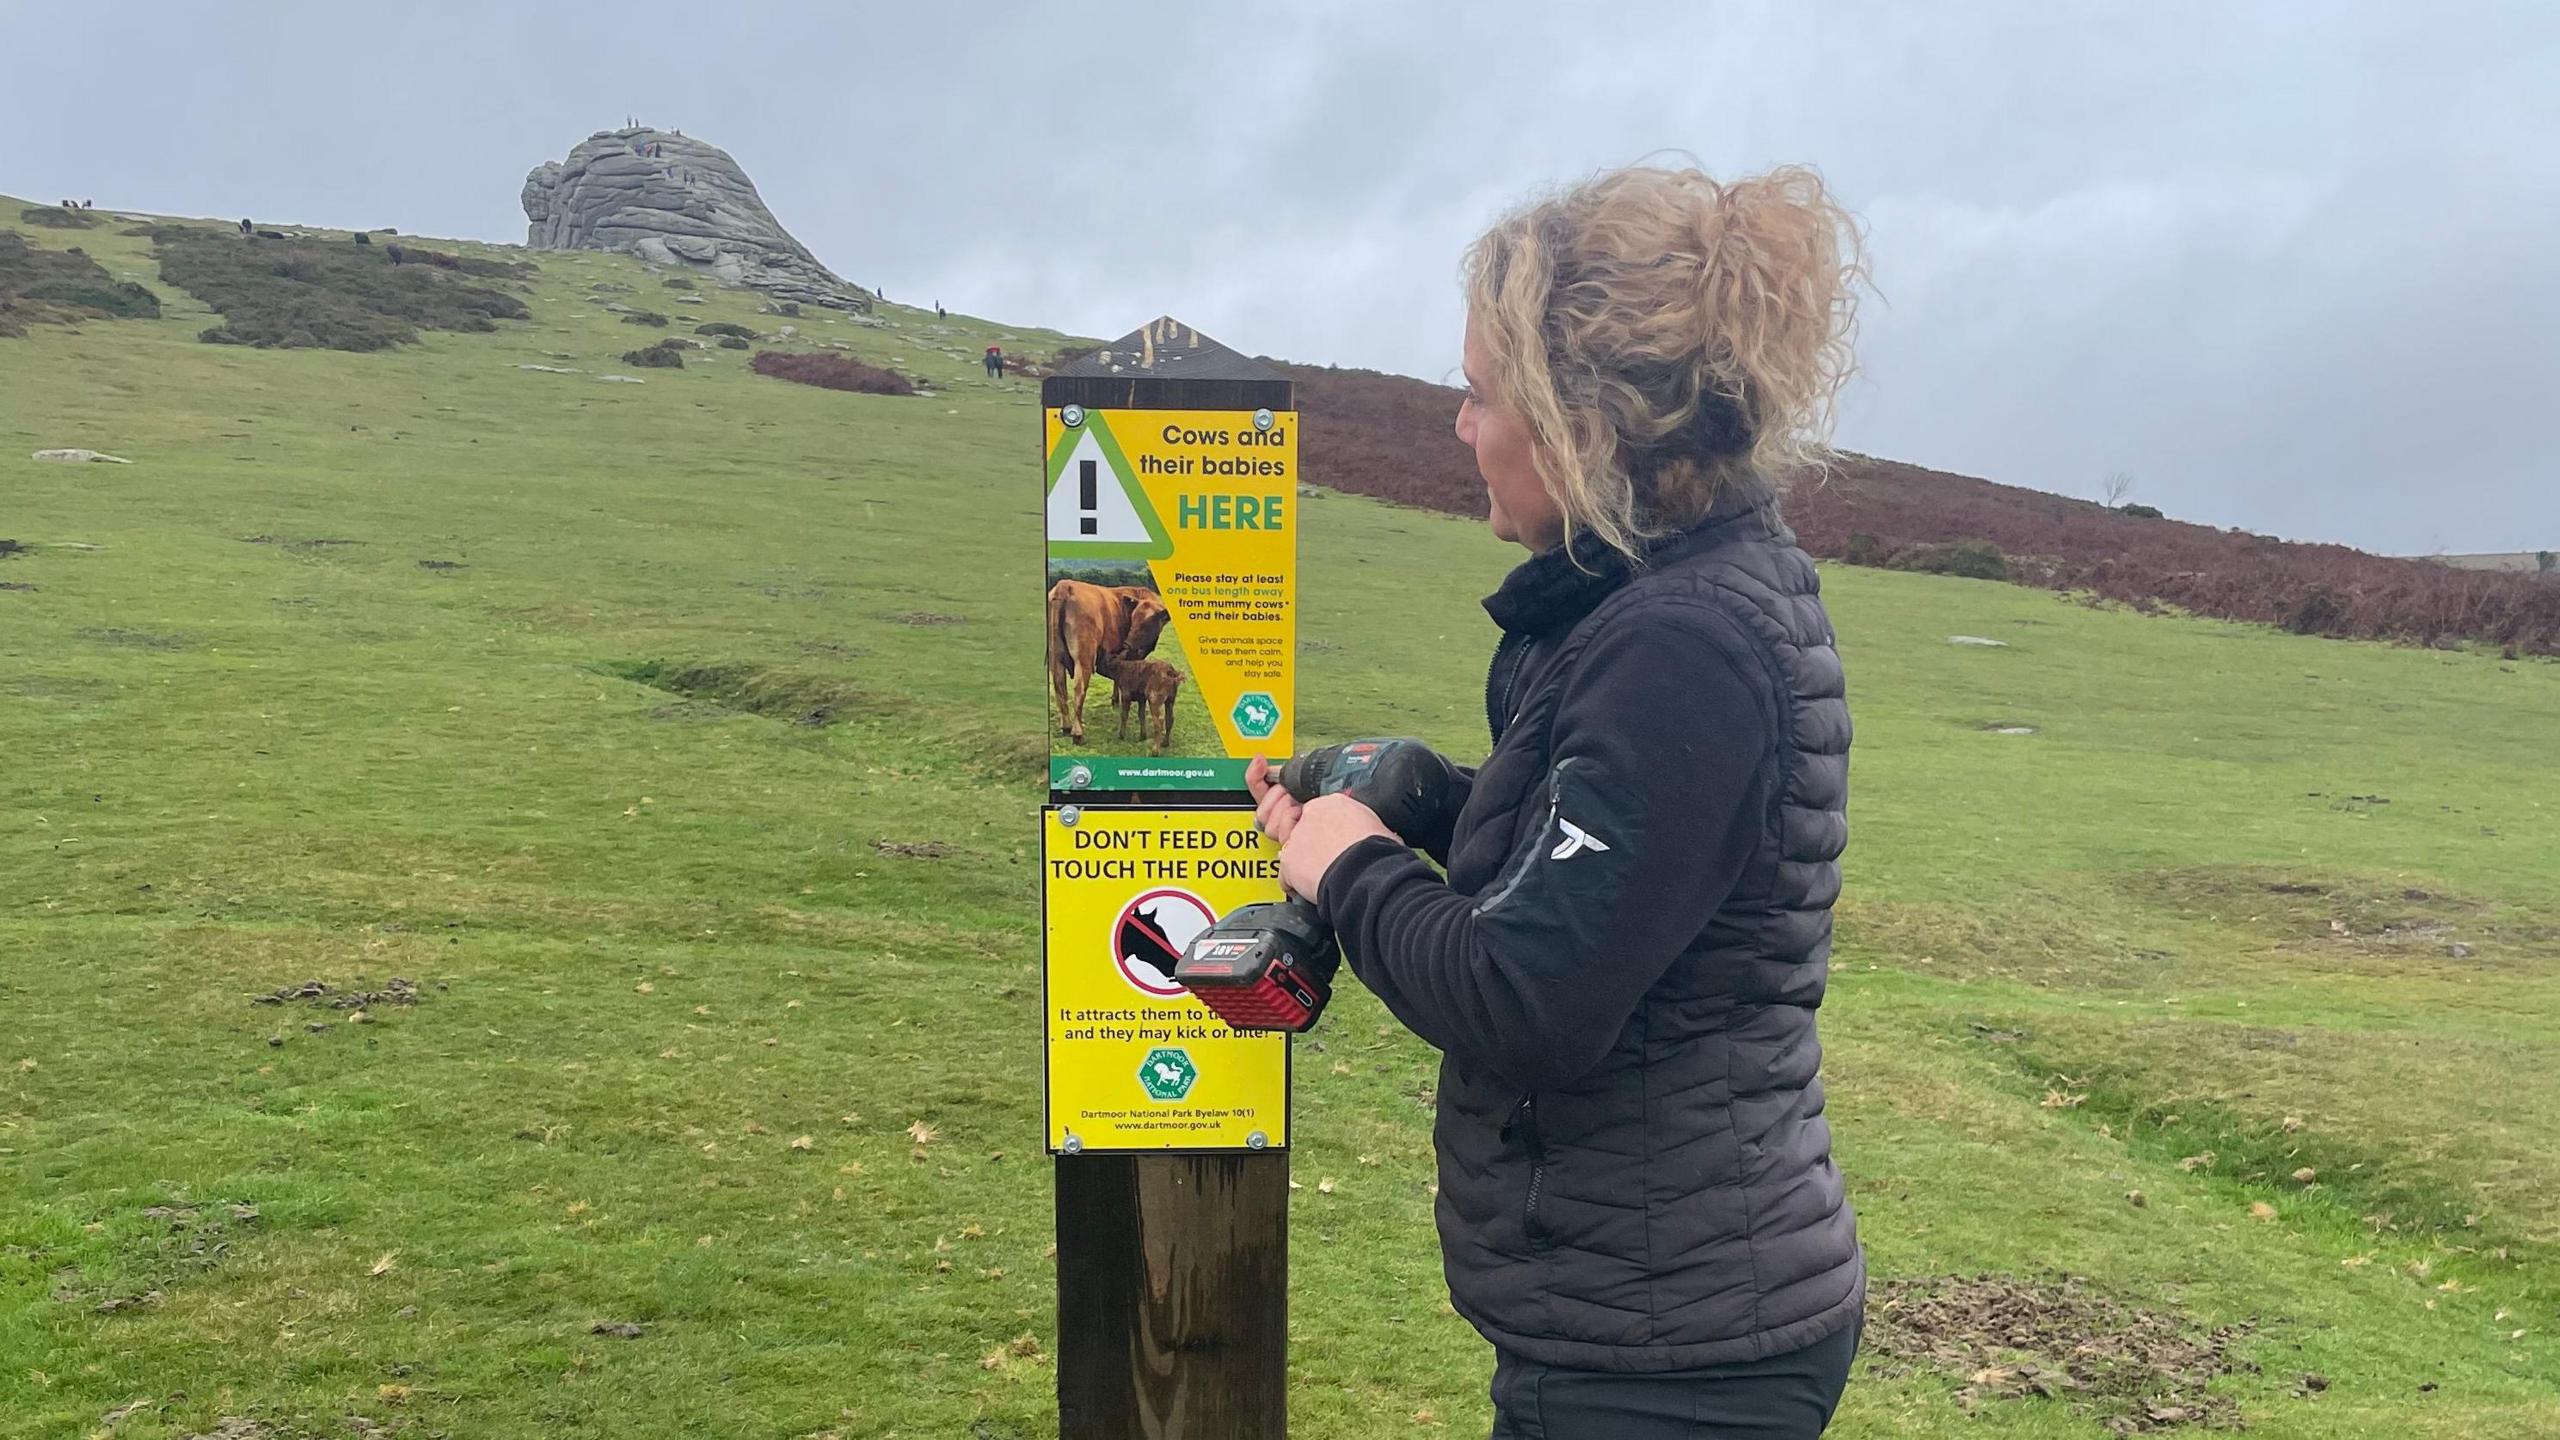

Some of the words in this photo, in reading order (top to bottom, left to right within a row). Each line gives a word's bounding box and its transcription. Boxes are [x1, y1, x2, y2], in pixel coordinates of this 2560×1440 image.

[1162, 425, 1229, 445] Cows
[1238, 427, 1285, 446] and
[1140, 454, 1194, 475] their
[1202, 455, 1285, 476] babies
[1179, 495, 1284, 530] HERE
[1175, 573, 1212, 583] Please
[1216, 574, 1239, 585] stay
[1242, 574, 1253, 583] at
[1257, 574, 1284, 584] least
[1167, 587, 1188, 595] one
[1191, 586, 1211, 595] bus
[1214, 586, 1250, 598] length
[1253, 588, 1284, 598] away
[1179, 598, 1204, 608] from
[1207, 600, 1252, 611] mummy
[1189, 612, 1211, 620] and
[1214, 612, 1239, 620] their
[1198, 636, 1218, 644] Give
[1220, 636, 1255, 645] animals
[1256, 637, 1283, 646] space
[1211, 648, 1233, 656] keep
[1245, 659, 1265, 667] help
[1244, 670, 1261, 678] stay
[1118, 768, 1215, 779] www.dartmoor.gov.uk
[1075, 830, 1152, 849] DON'T
[1159, 830, 1217, 849] FEED
[1225, 830, 1260, 849] OR
[1051, 860, 1135, 879] TOUCH
[1143, 860, 1189, 879] THE
[1197, 860, 1281, 879] PONIES
[1060, 1008, 1072, 1021] It
[1076, 1009, 1136, 1021] attracts
[1141, 1008, 1181, 1021] them
[1187, 1008, 1203, 1020] to
[1065, 1026, 1094, 1039] and
[1099, 1026, 1135, 1042] they
[1139, 1028, 1172, 1042] may
[1177, 1025, 1207, 1039] kick
[1212, 1028, 1228, 1039] or
[1146, 1051, 1189, 1067] DARTMOOR
[1143, 1075, 1178, 1098] NATIONAL
[1081, 1110, 1127, 1119] Dartmoor
[1129, 1109, 1170, 1118] National
[1172, 1109, 1192, 1118] Park
[1195, 1109, 1230, 1119] Byelaw
[1232, 1108, 1255, 1118] 10(1)
[1115, 1121, 1221, 1131] www.dartmoor.gov.uk
